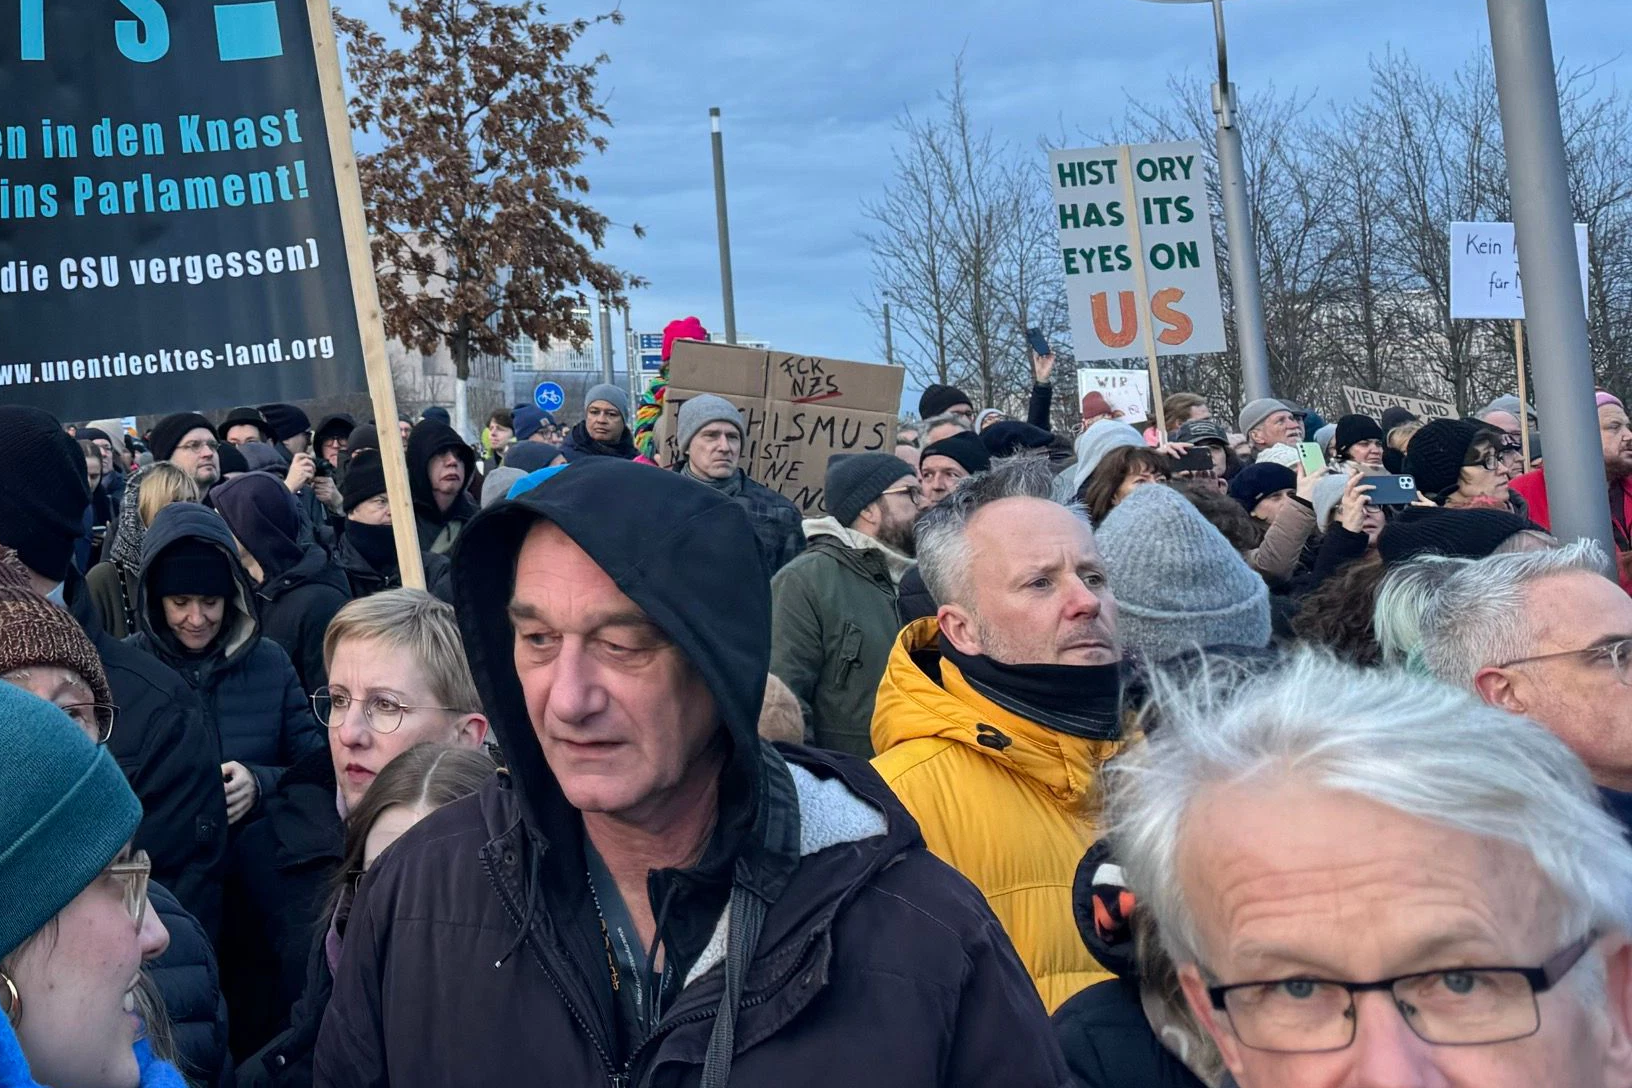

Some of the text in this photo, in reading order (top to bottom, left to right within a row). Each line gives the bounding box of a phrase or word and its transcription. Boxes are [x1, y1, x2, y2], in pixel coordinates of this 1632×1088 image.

[41, 118, 78, 159] in
[91, 117, 165, 157] den
[178, 108, 303, 154] Knast
[0, 178, 59, 219] ins
[73, 160, 310, 216] Parlament!
[1059, 195, 1194, 229] HAS ITS
[1062, 241, 1200, 275] EYES ON
[1466, 232, 1502, 255] Kein
[0, 260, 49, 293] die
[59, 255, 120, 290] CSU
[129, 237, 320, 286] vergessen)
[1488, 270, 1510, 298] für
[1090, 287, 1193, 349] US
[779, 356, 825, 377] FCK
[790, 373, 842, 397] NZS
[1419, 402, 1449, 417] UND
